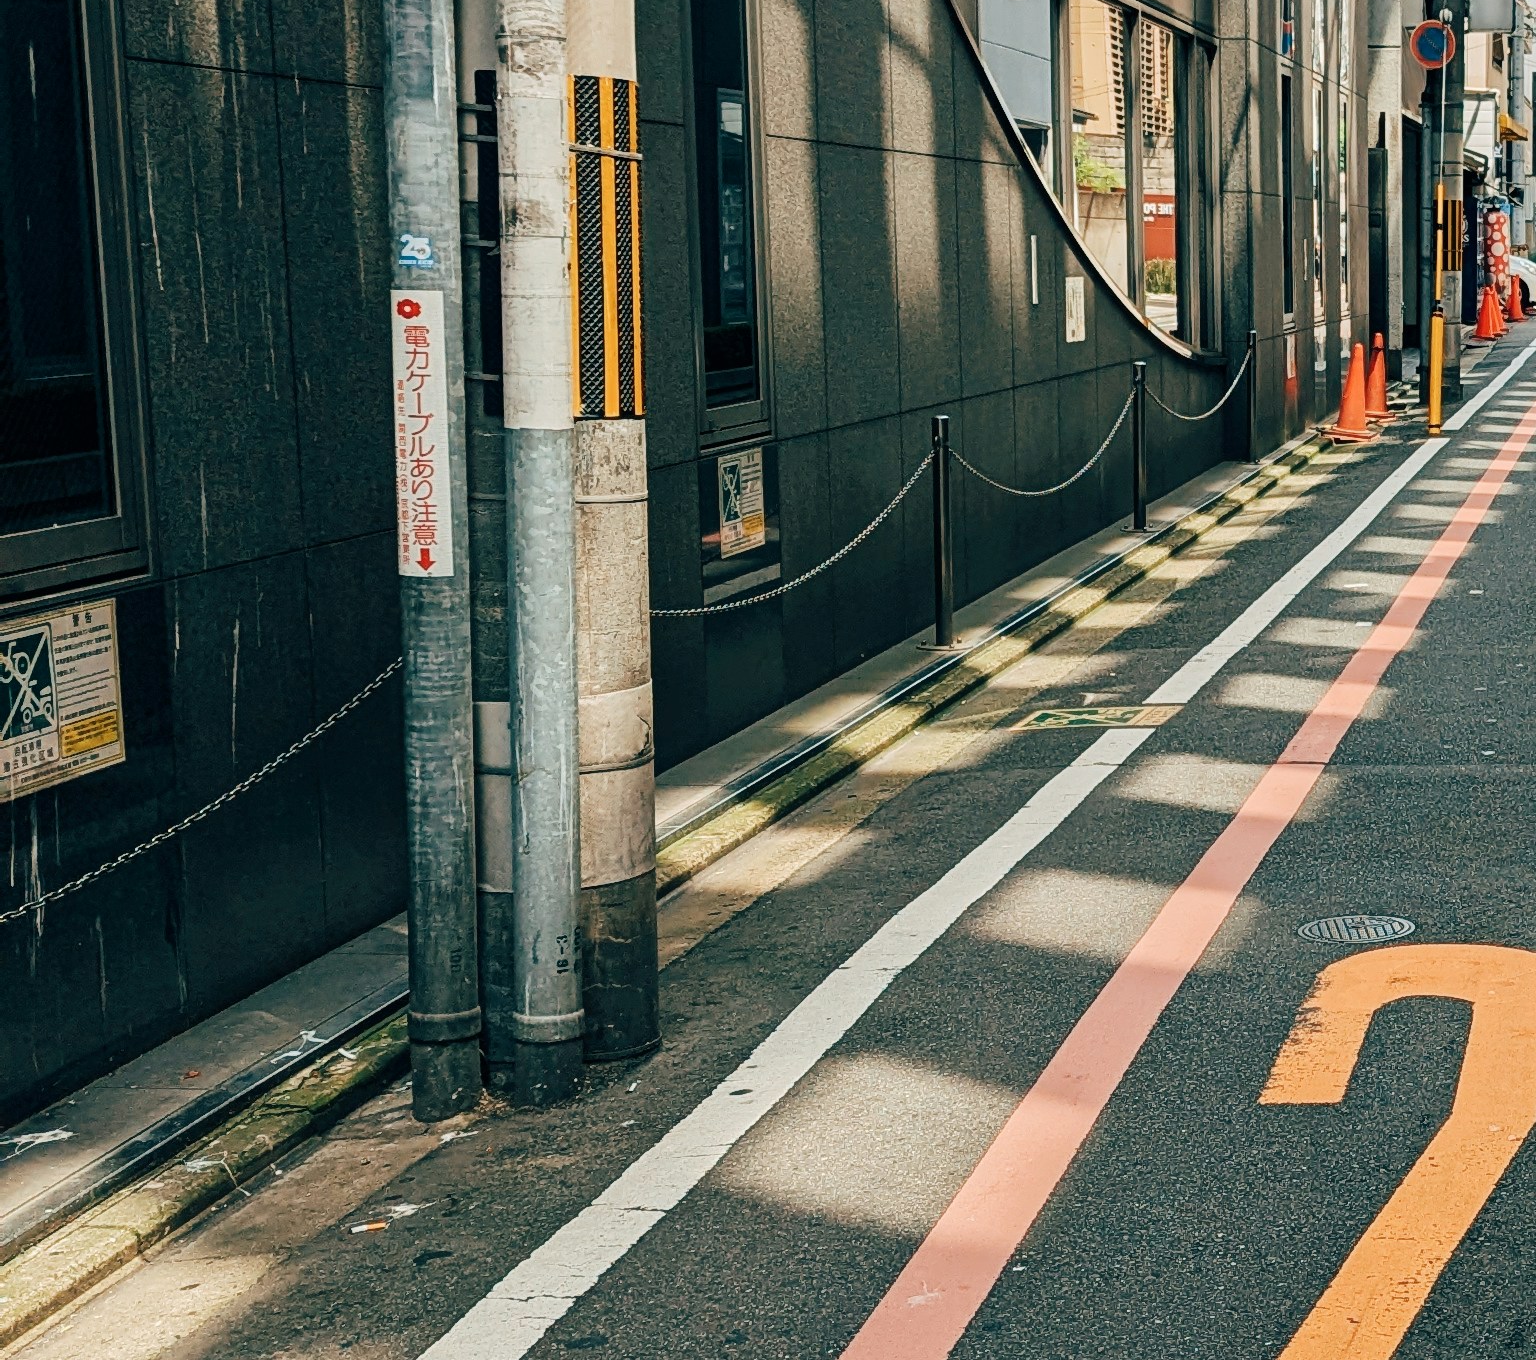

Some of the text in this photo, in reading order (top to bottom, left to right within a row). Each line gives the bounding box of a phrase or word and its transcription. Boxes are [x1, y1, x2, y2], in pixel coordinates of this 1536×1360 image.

[404, 326, 438, 545] 電力ケーブルあり注意
